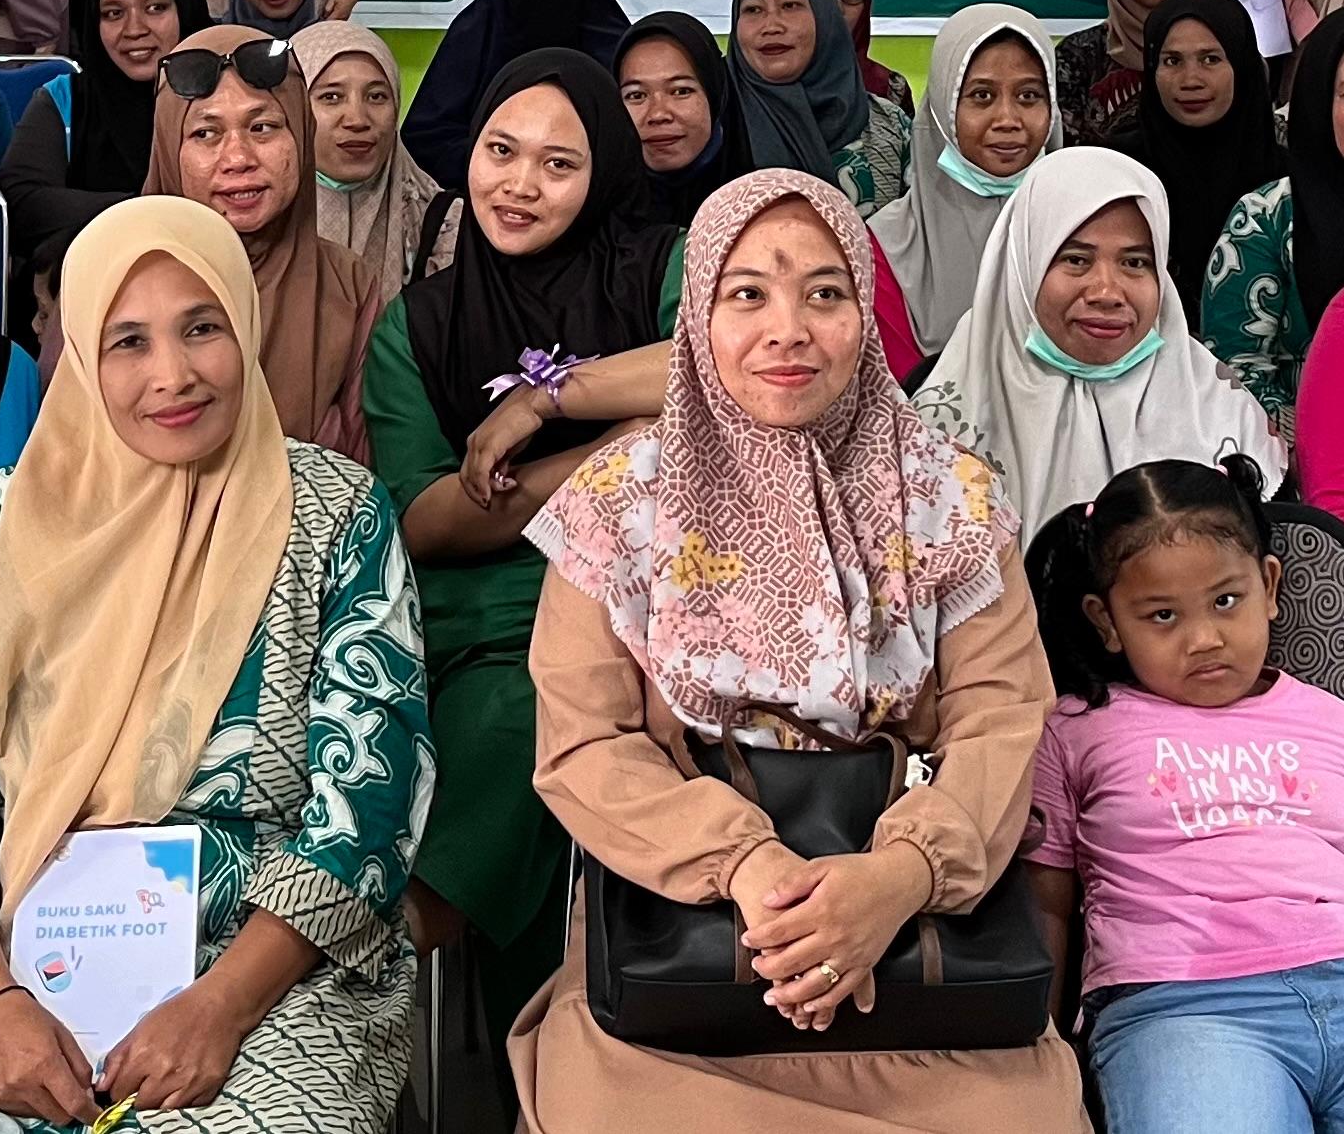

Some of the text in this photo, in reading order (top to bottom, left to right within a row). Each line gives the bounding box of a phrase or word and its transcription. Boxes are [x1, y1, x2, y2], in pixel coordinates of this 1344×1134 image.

[1156, 737, 1301, 777] ALWAYS
[37, 903, 127, 918] BUKU SAKU
[35, 921, 169, 940] DIABETIK FOOT
